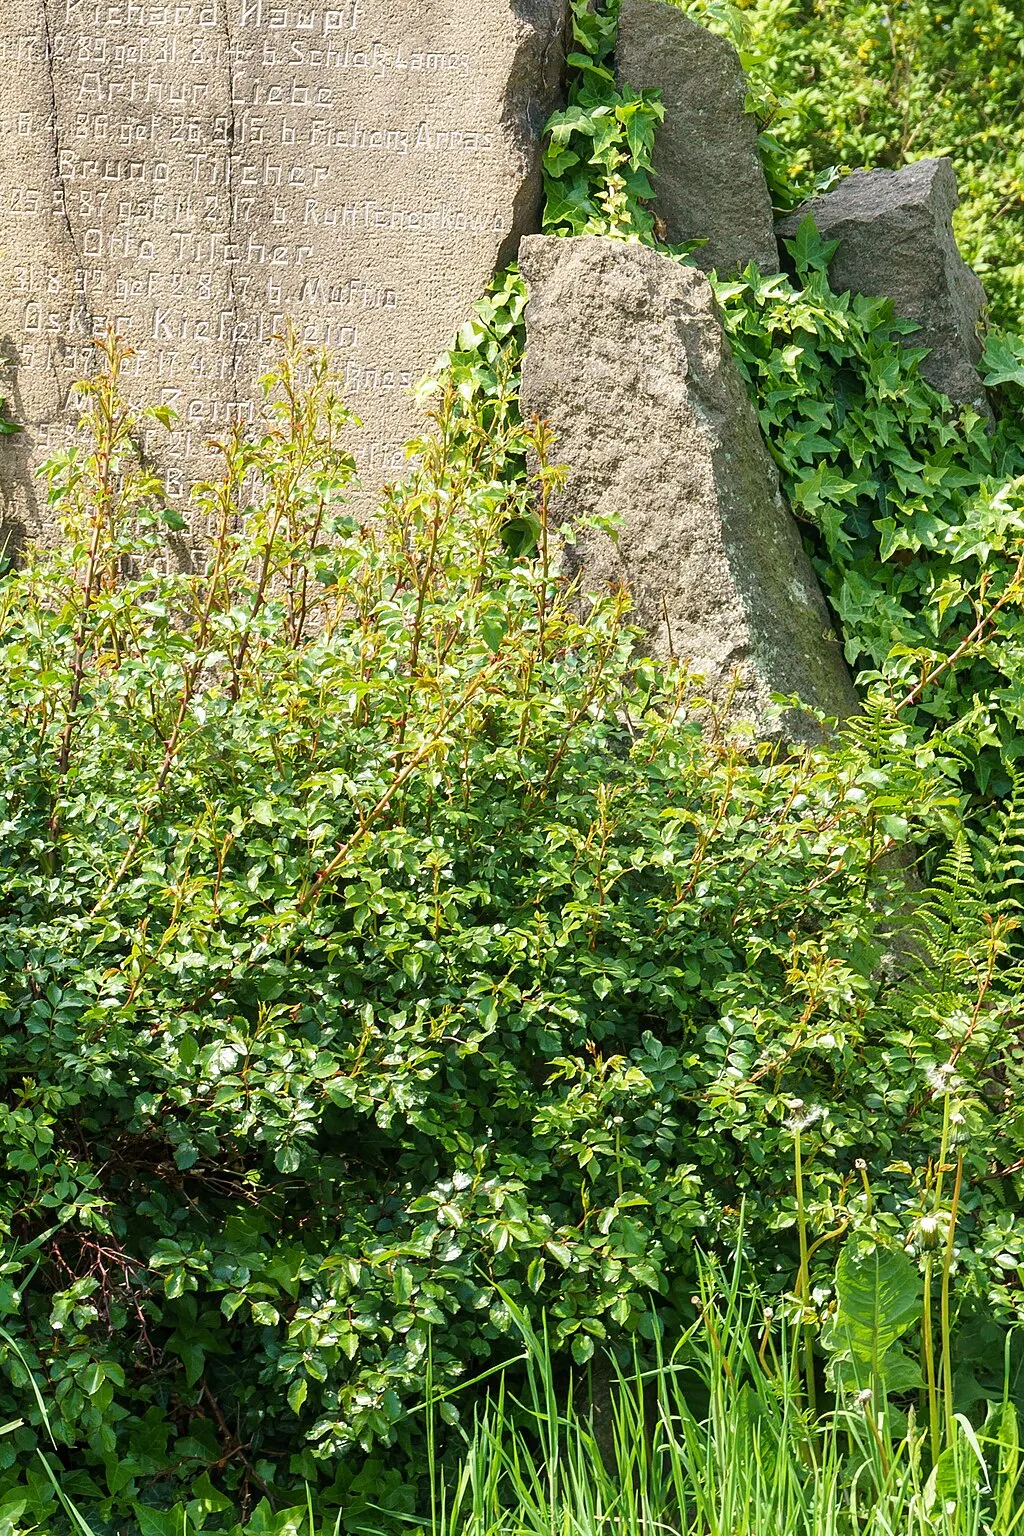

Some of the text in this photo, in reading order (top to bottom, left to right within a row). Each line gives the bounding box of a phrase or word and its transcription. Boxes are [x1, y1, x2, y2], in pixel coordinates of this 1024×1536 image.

[77, 70, 336, 109] Arthur Liebe
[59, 149, 170, 182] Bruno
[84, 229, 156, 259] Otto
[25, 300, 132, 339] Oskar
